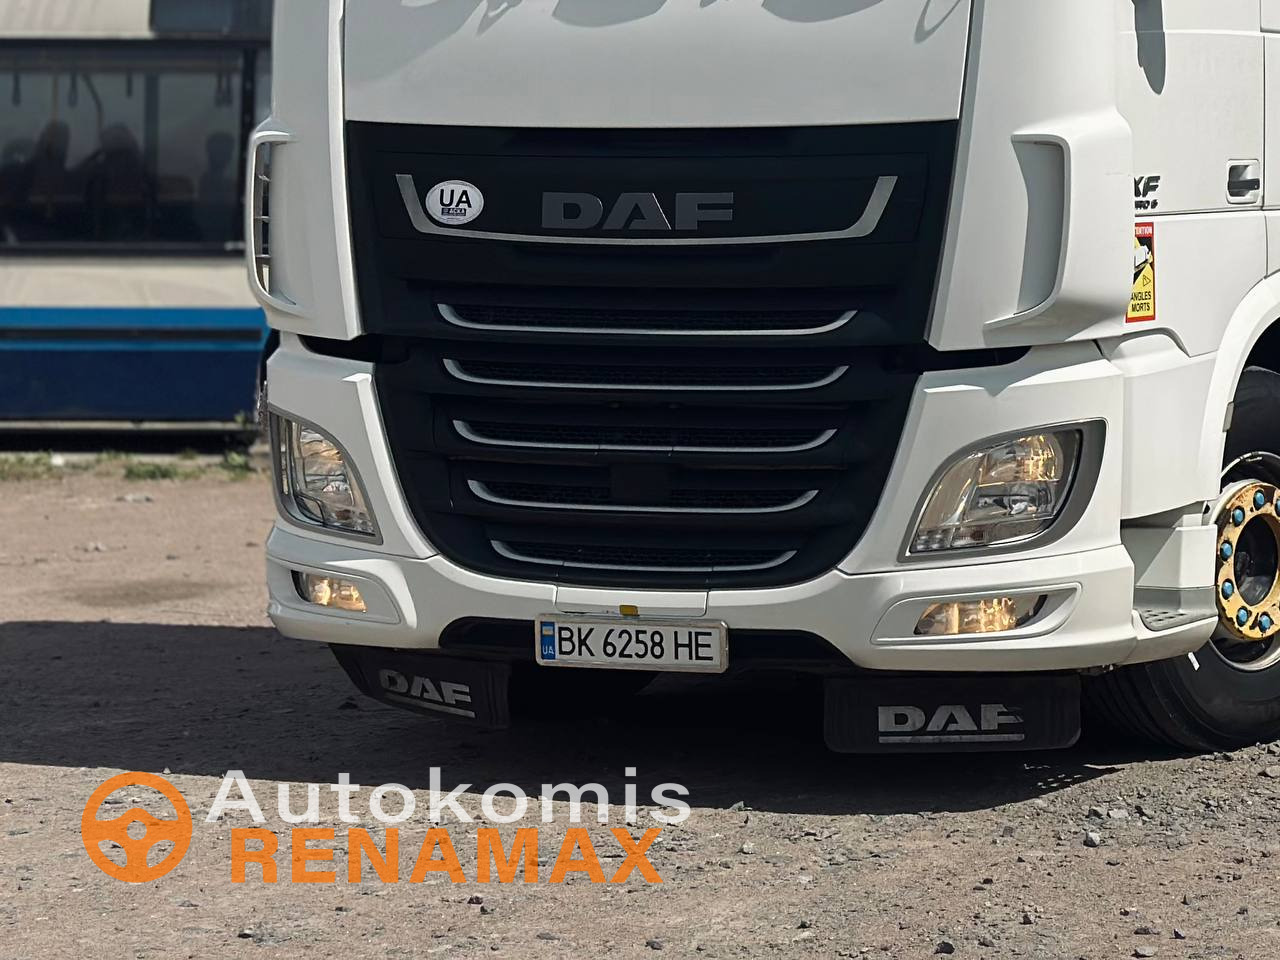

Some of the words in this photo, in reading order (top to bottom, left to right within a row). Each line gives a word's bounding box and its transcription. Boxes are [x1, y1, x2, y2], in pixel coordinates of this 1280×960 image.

[440, 189, 472, 208] UA
[541, 192, 733, 230] DAF
[1130, 291, 1152, 301] ANGLES
[1131, 302, 1151, 312] MORTS
[543, 646, 554, 655] UA
[558, 626, 595, 657] BK
[602, 629, 664, 659] 6258
[673, 631, 713, 661] HE
[380, 669, 472, 704] DAF
[878, 704, 1024, 732] DAF
